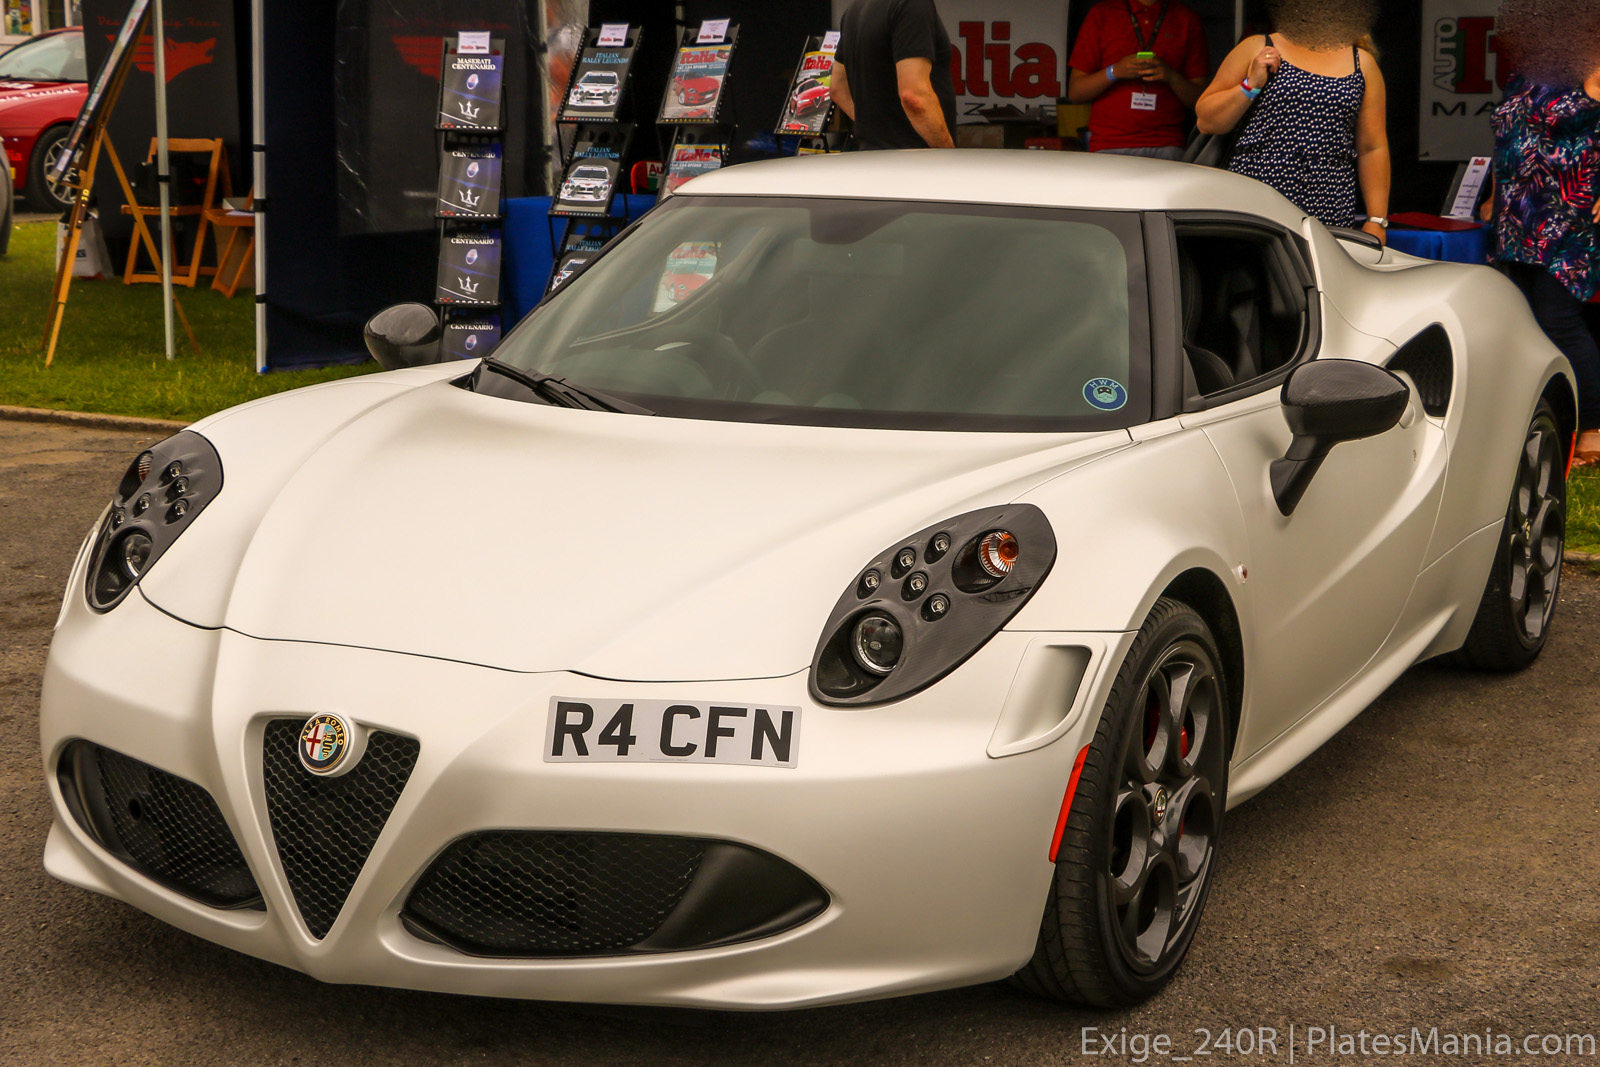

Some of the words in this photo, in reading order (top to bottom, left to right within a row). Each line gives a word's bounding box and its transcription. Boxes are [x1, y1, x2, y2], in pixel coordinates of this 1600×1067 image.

[680, 50, 717, 65] Italia
[803, 55, 832, 70] Italia
[1433, 17, 1458, 93] AUTO
[451, 63, 497, 71] CENTENARIO
[452, 151, 496, 159] CENTENARIO
[674, 149, 711, 162] Italia
[1089, 379, 1119, 389] HWM
[302, 718, 321, 741] ALFA
[325, 717, 344, 746] ROMEO
[551, 701, 637, 757] R4
[659, 704, 794, 763] CFN
